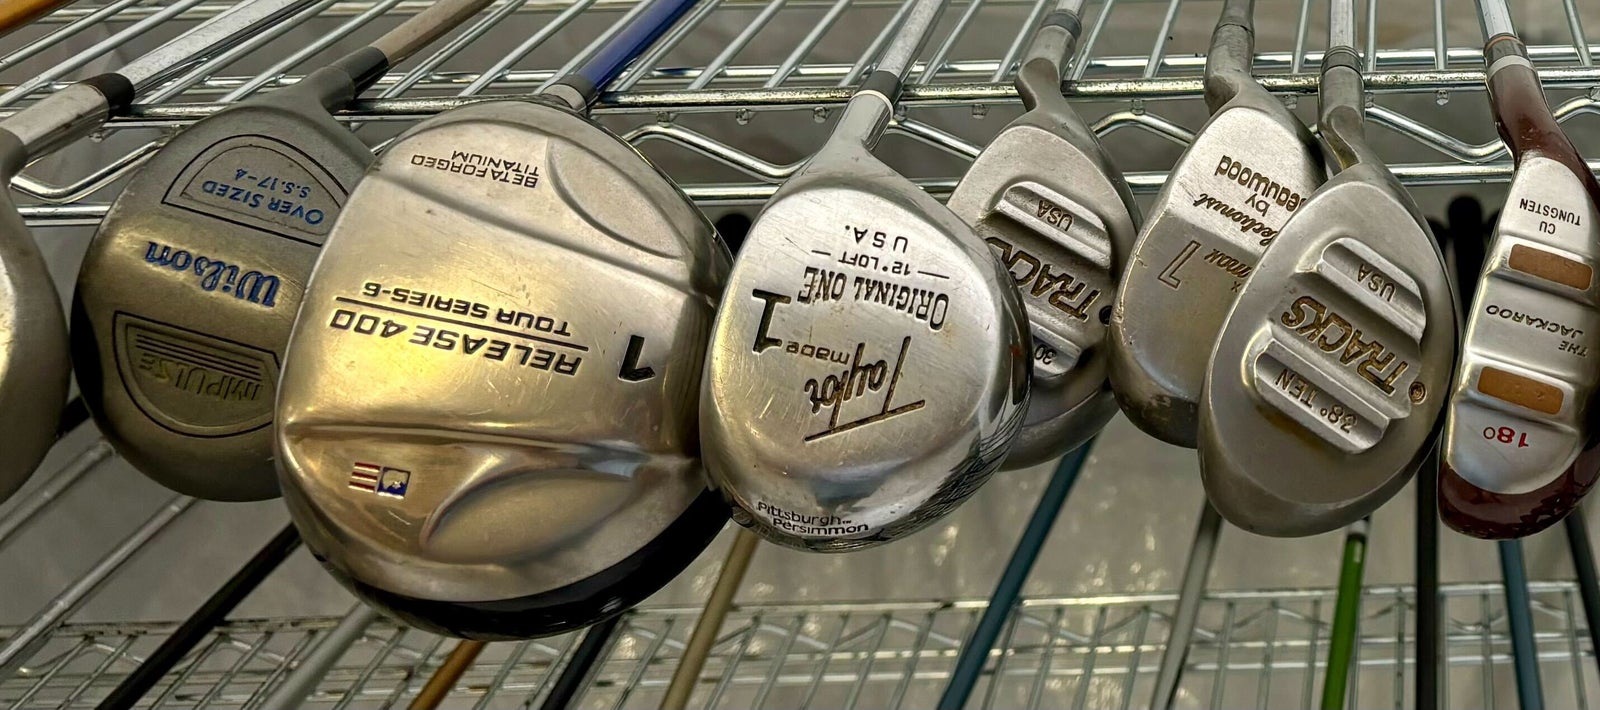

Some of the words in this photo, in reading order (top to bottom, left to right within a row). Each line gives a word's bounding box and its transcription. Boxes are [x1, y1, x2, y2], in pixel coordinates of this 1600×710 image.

[452, 150, 539, 176] TITANIUM
[202, 180, 262, 209] SIZED
[1214, 155, 1306, 212] eauwood
[267, 197, 324, 225] OVER
[1036, 200, 1074, 232] USA
[1245, 193, 1270, 217] by
[1520, 197, 1581, 226] TUNGSTEN
[1539, 221, 1556, 234] CU
[145, 241, 281, 307] Wilson
[838, 251, 878, 271] LOFT
[1157, 240, 1201, 289] 7
[797, 266, 847, 305] ONE
[1357, 263, 1396, 302] USA
[363, 282, 490, 319] SERIES-6
[853, 277, 949, 331] ORIGINAL
[330, 309, 407, 339] 400
[496, 311, 572, 337] TOUR
[752, 288, 791, 354] 1
[1485, 304, 1584, 338] JACKAROO
[409, 325, 582, 377] RELEASE
[618, 334, 656, 382] 1
[1281, 295, 1408, 396] TRACKS
[1558, 340, 1587, 357] THE
[804, 336, 926, 442] Taylor
[1275, 368, 1318, 408] TEN
[773, 517, 869, 535] Persimmon
